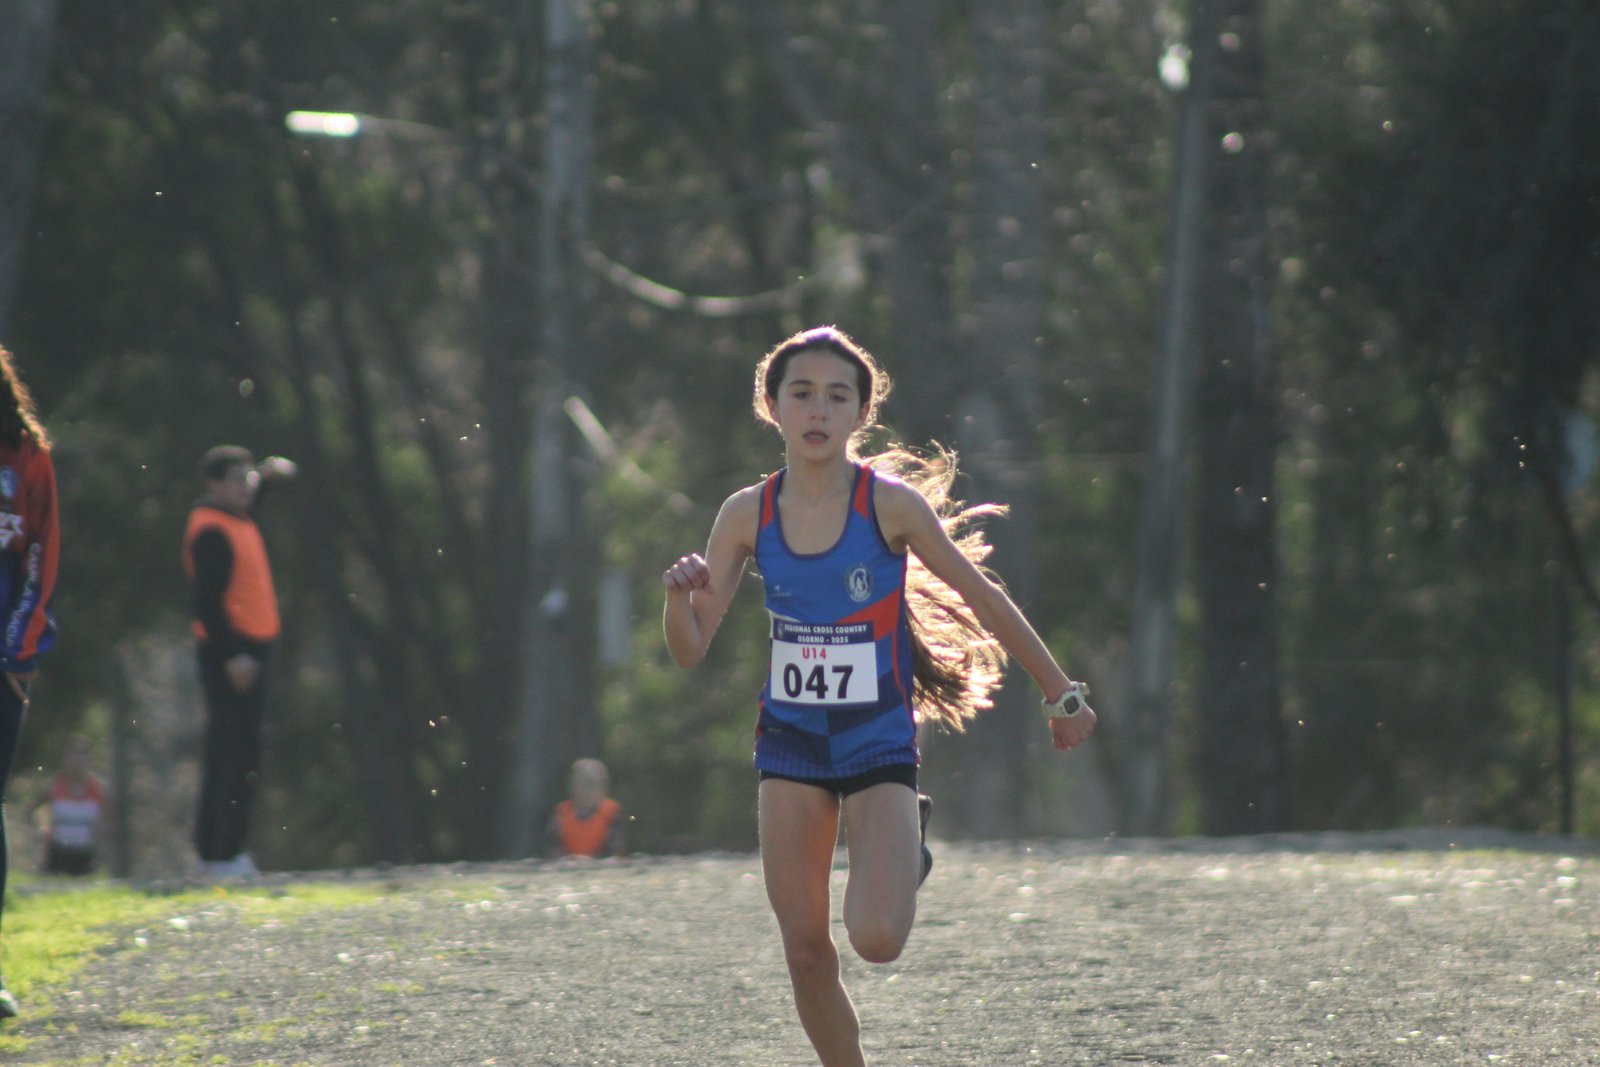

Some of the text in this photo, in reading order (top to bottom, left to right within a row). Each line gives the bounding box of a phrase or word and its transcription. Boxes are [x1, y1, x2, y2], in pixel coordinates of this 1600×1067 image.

[22, 543, 41, 595] CAMILA
[784, 624, 811, 633] REGIONAL
[835, 624, 867, 633] COUNTRY
[797, 635, 825, 643] OSORNO
[802, 647, 827, 659] U14
[783, 662, 854, 699] 047
